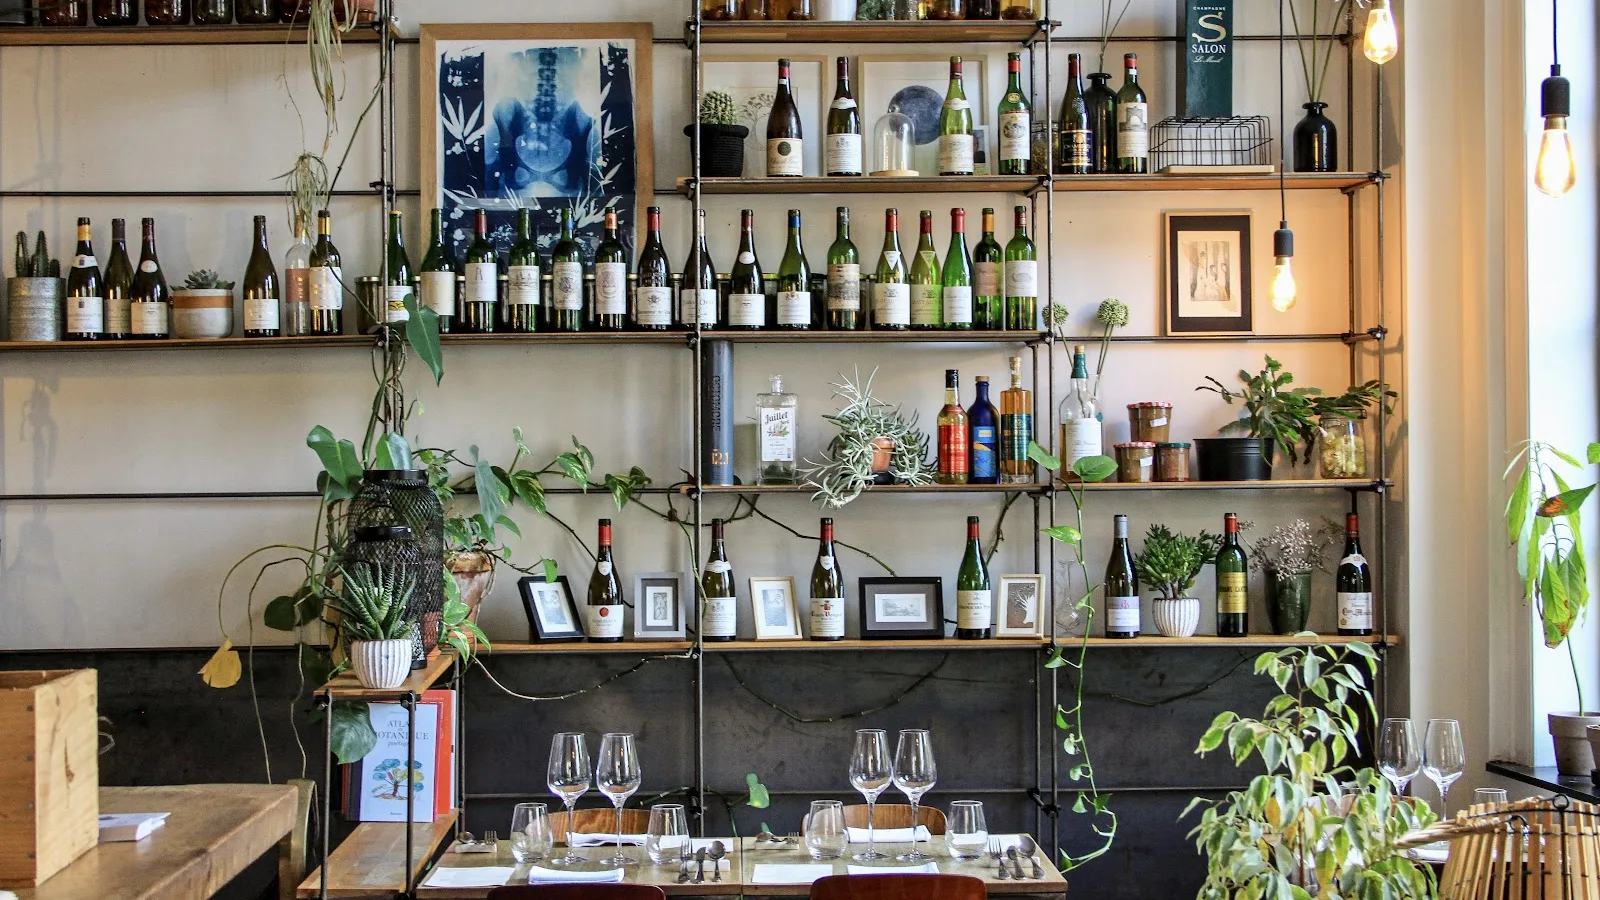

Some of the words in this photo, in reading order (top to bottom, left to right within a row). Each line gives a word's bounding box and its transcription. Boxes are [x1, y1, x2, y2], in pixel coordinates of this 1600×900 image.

[1191, 11, 1227, 43] S
[1191, 44, 1226, 53] SALON
[765, 412, 788, 425] Juillet
[387, 719, 409, 728] ATLA
